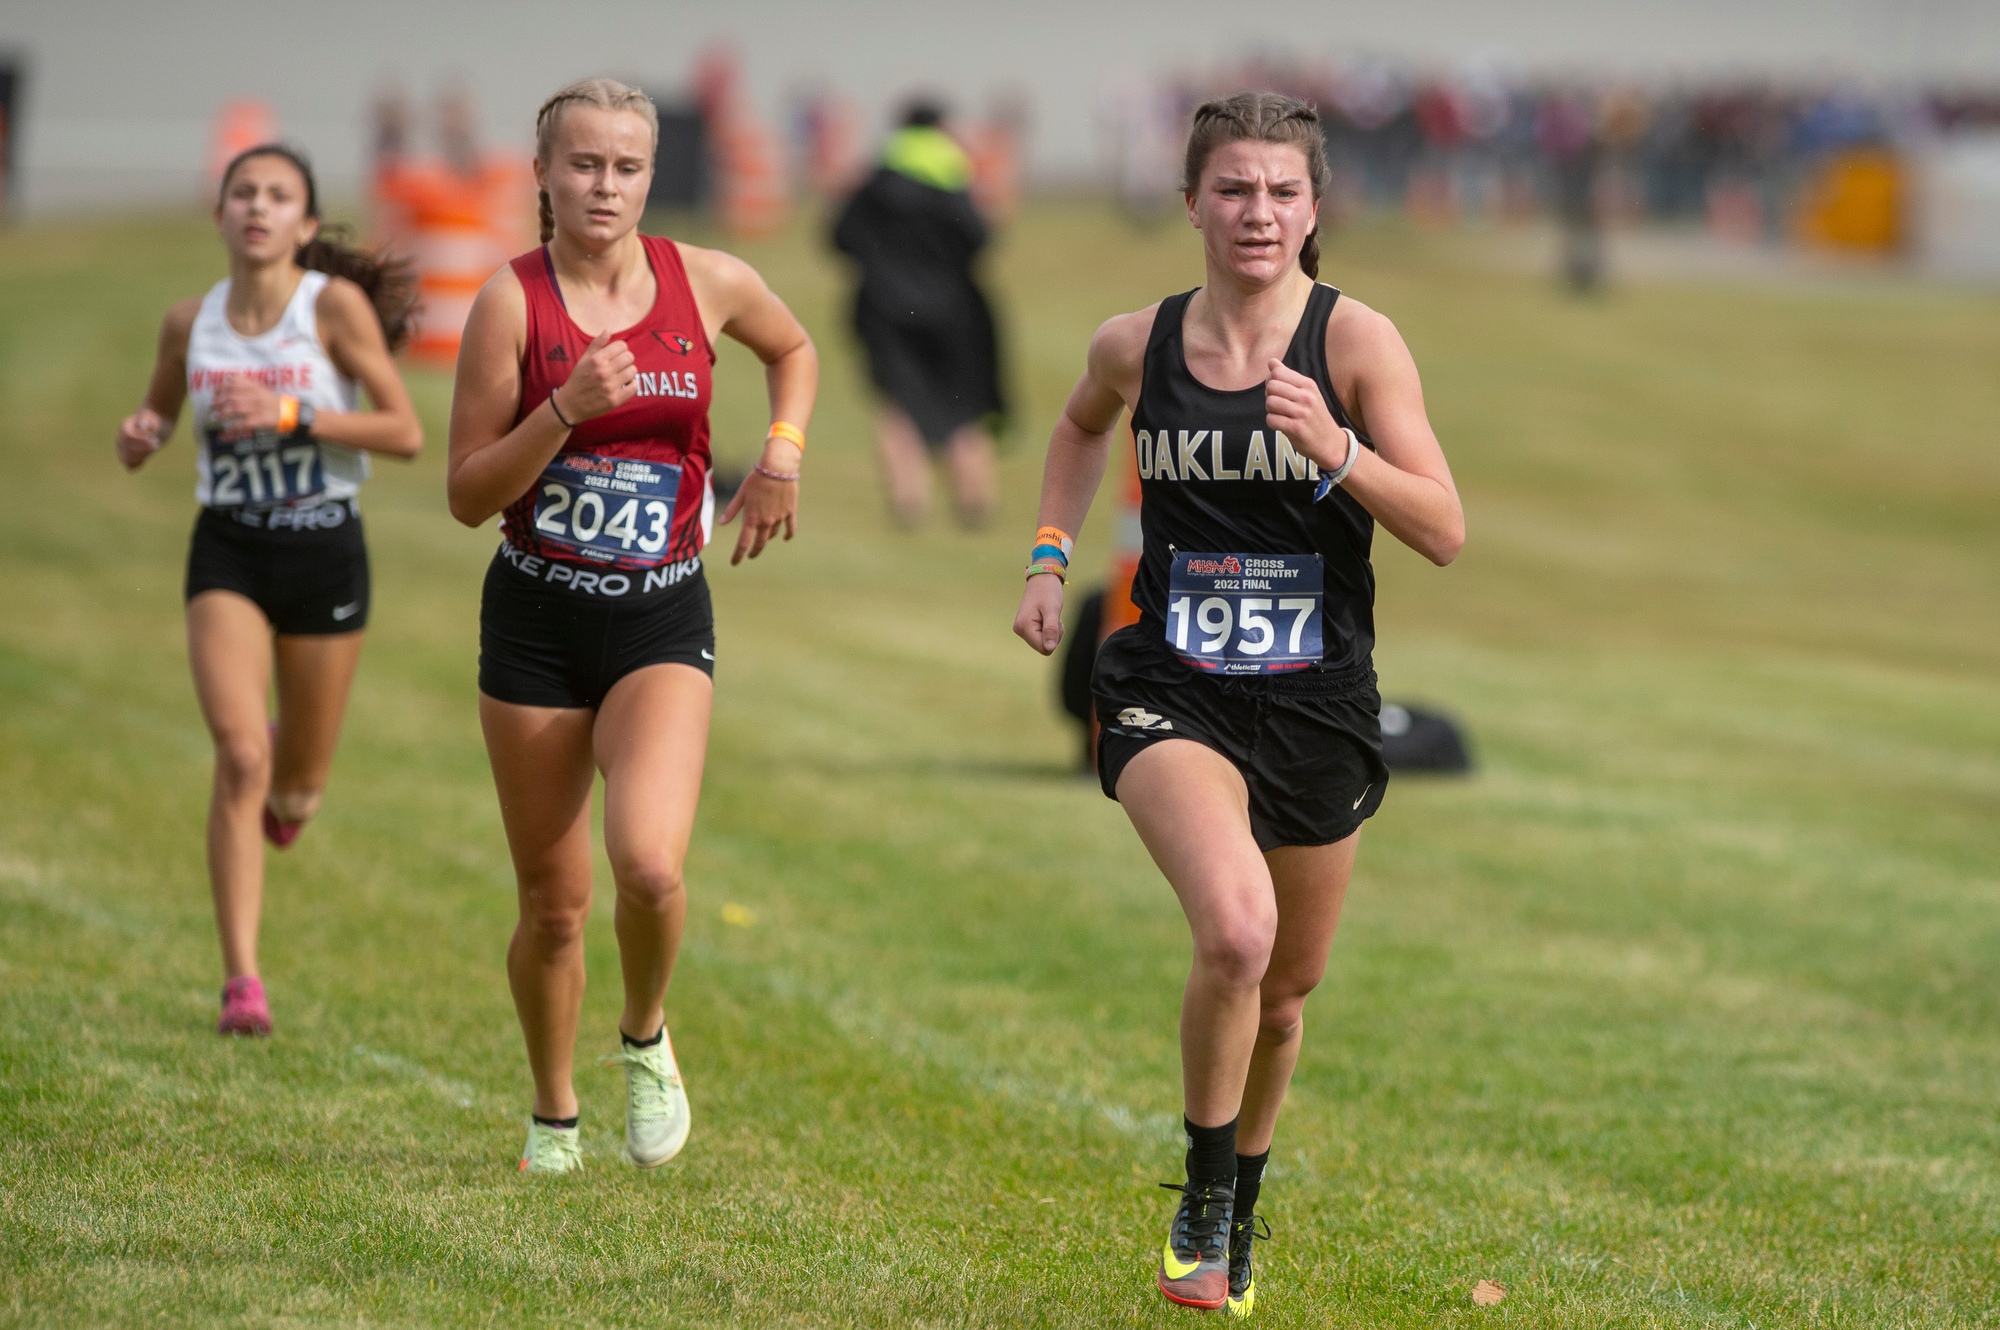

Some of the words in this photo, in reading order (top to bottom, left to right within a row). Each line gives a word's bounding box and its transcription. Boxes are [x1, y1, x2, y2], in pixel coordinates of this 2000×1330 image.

[190, 366, 313, 391] WHORE
[1137, 430, 1320, 481] OAKLAN
[213, 446, 317, 504] 2117
[615, 470, 662, 484] COUNTRY
[616, 462, 652, 474] CROSS
[584, 475, 610, 488] 2022
[610, 479, 638, 493] FINAL
[535, 484, 670, 553] 2043
[502, 538, 545, 577] IKE
[545, 564, 630, 597] PRO
[1187, 558, 1234, 574] MHSAA
[1245, 558, 1285, 569] CROSS
[1245, 568, 1299, 578] COUNTRY
[1214, 579, 1240, 590] 2022
[1242, 580, 1272, 590] FINAL
[1171, 596, 1316, 655] 1957
